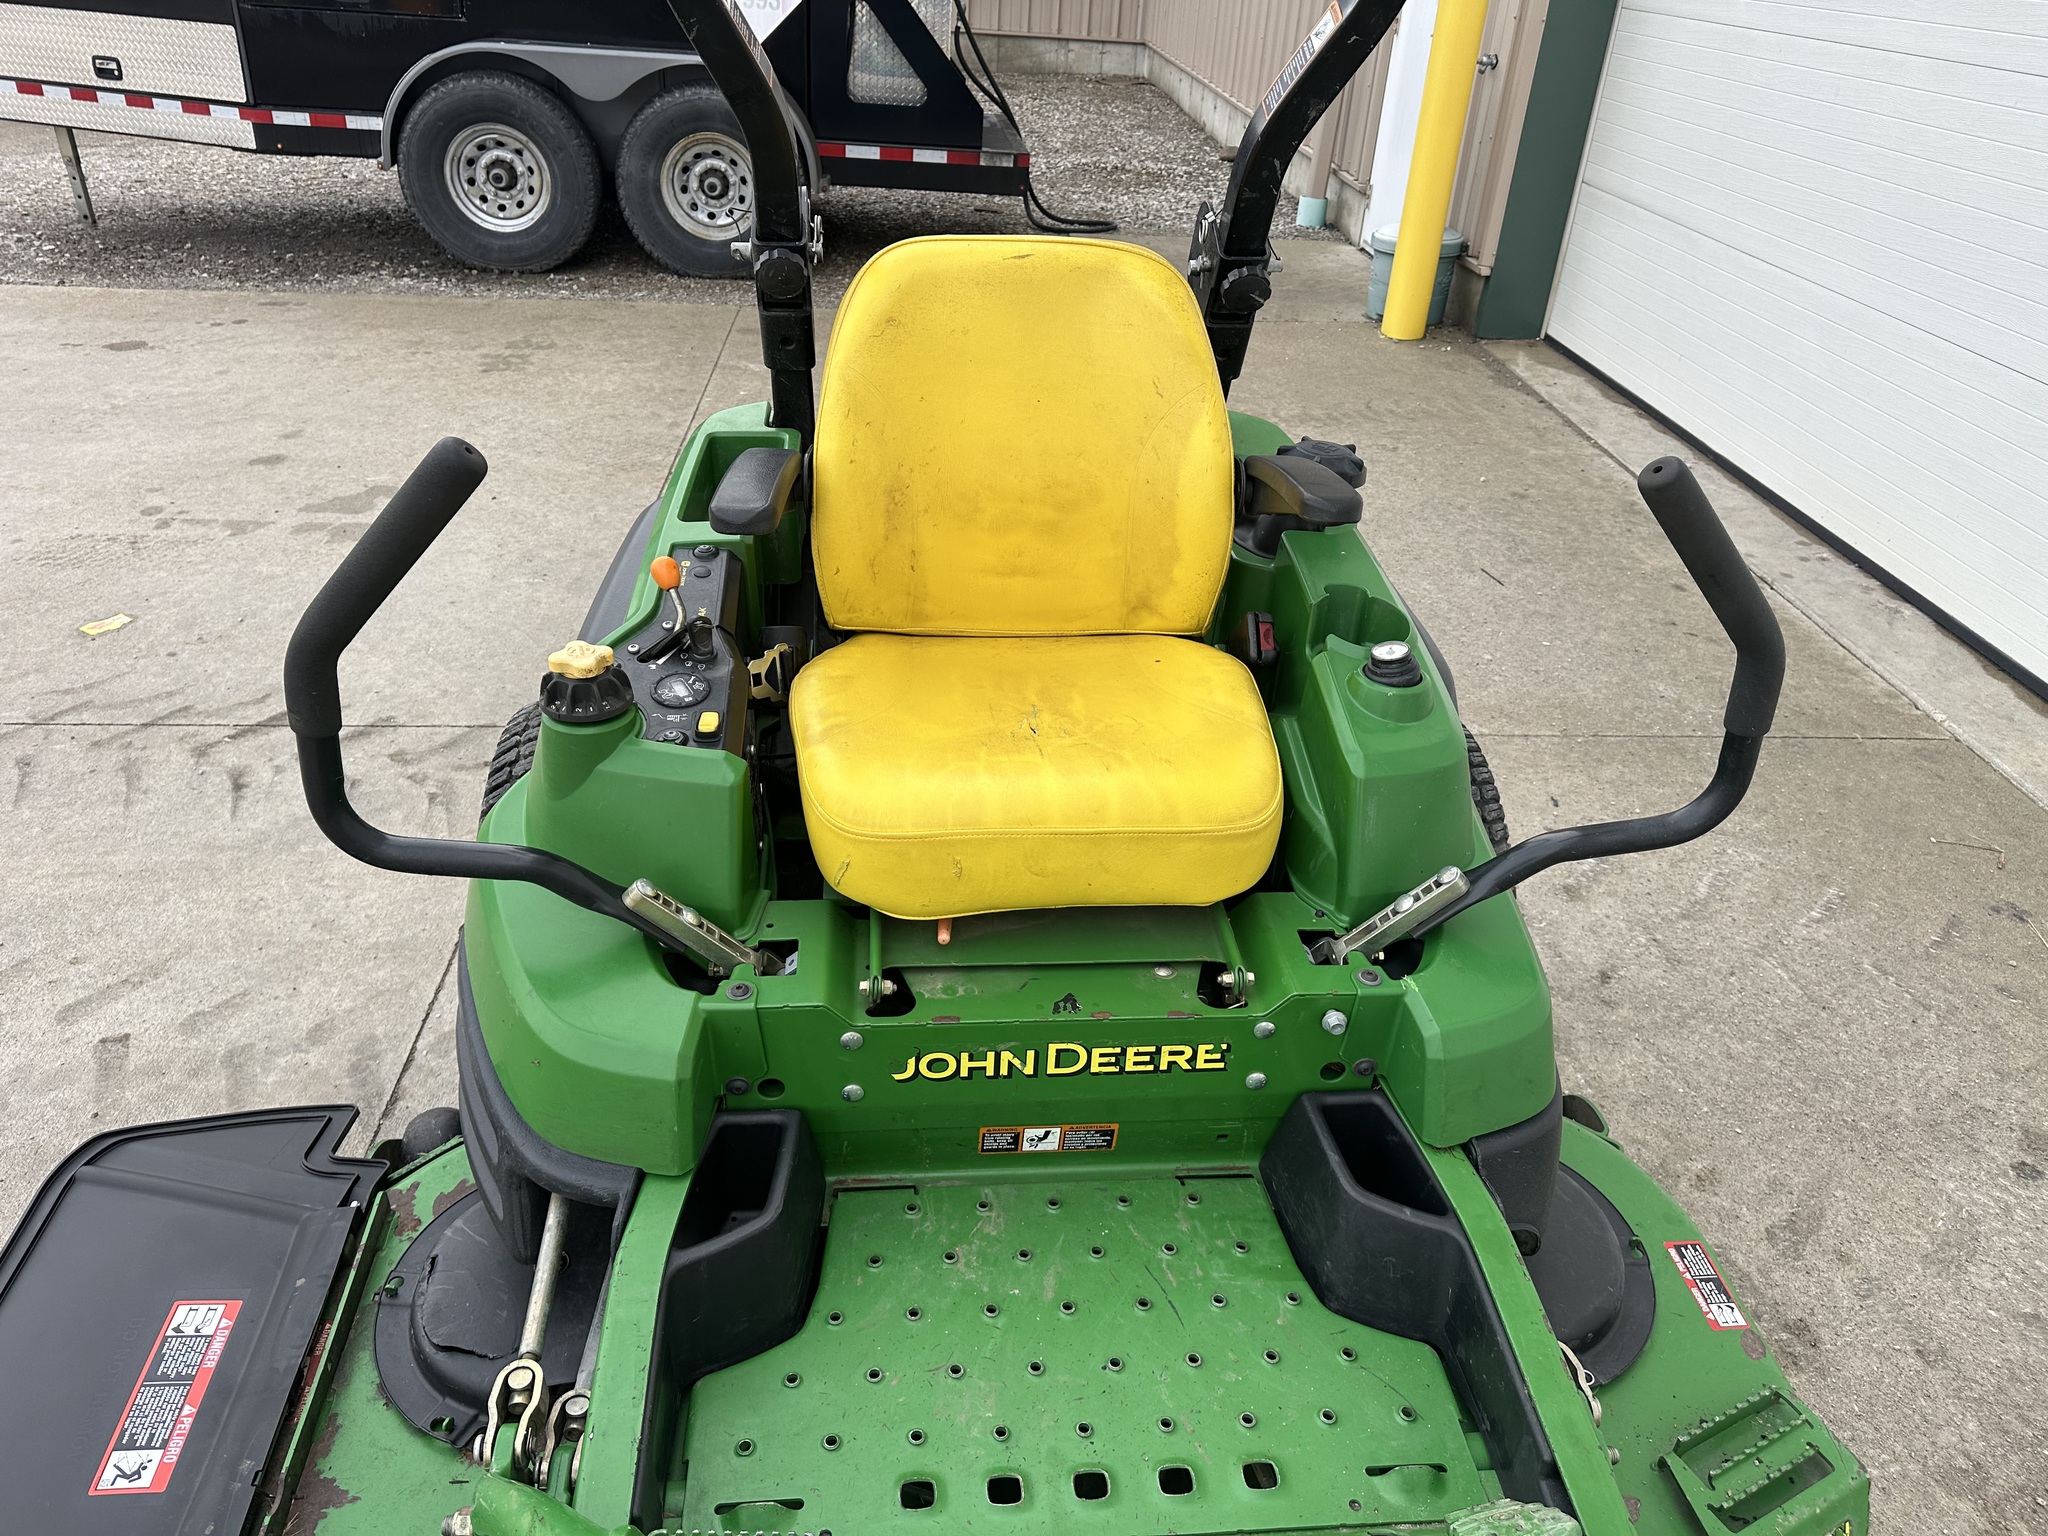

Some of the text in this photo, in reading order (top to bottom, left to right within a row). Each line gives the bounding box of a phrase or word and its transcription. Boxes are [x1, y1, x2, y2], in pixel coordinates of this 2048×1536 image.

[891, 1043, 1230, 1081] JOHN DEERE
[1690, 1287, 1710, 1312] DANGER
[202, 1330, 227, 1369] DANGER
[313, 1329, 330, 1356] DANGER
[162, 1416, 192, 1464] PELIGRO
